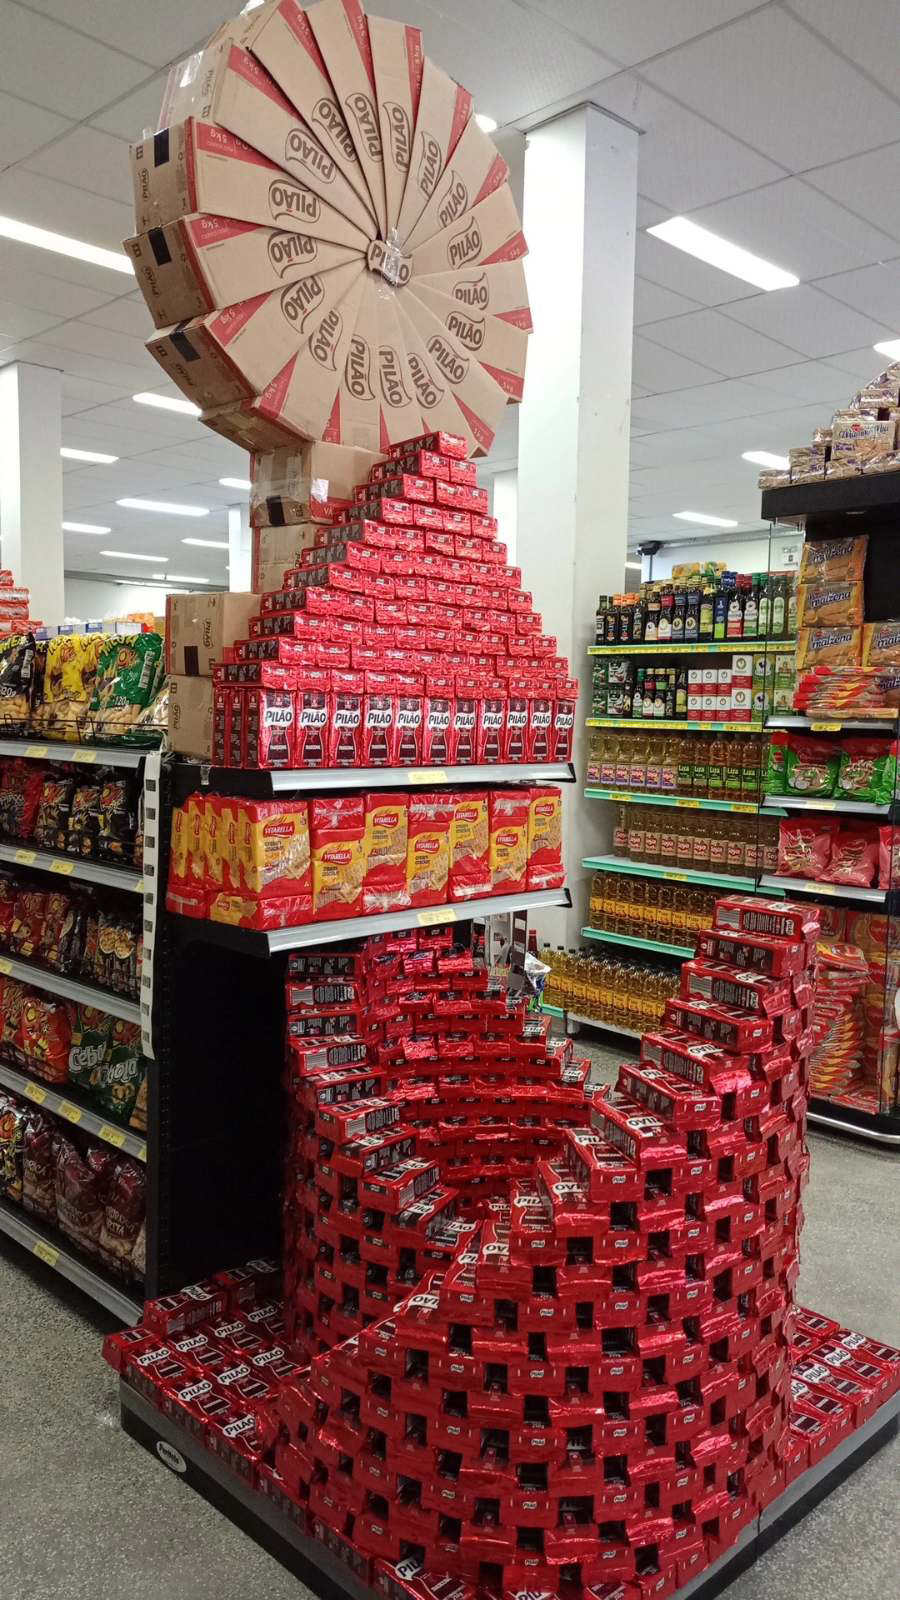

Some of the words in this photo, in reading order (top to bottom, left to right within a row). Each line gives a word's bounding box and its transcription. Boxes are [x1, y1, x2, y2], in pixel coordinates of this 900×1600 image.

[354, 97, 381, 158] PILÃO
[391, 107, 410, 170] PILÃO
[289, 133, 335, 181] PILÃO
[420, 140, 439, 197] PILÃO
[271, 186, 317, 218] PILÃO
[439, 182, 466, 229] PILÃO
[270, 234, 316, 263] PILÃO
[450, 229, 480, 266] PILÃO
[369, 243, 410, 282] PIO
[284, 275, 322, 322] PILÃO
[455, 283, 488, 306] PILÃO
[313, 309, 339, 362] PILÃO
[448, 315, 483, 347] PILÃO
[350, 337, 368, 397] PILÃO
[428, 338, 465, 381] PILÃO
[379, 350, 403, 406] PILÃO
[408, 355, 437, 407] PILÃO
[811, 591, 851, 609] maizena
[812, 634, 852, 650] maizena
[877, 636, 900, 650] maiz
[265, 710, 292, 724] PILÃO
[301, 711, 326, 725] PILÃO
[335, 712, 360, 725] PILÃO
[368, 712, 392, 725] PILÃO
[397, 712, 420, 725] PILÃO
[428, 714, 450, 726] PILÃO
[455, 714, 475, 726] PILÃO
[483, 714, 503, 726] PILÃO
[508, 713, 527, 725] PILÃO
[532, 713, 551, 725] PILÃO
[555, 715, 573, 727] PILÃO
[416, 842, 438, 850] VITARELLA
[249, 1306, 278, 1322] PILÃO
[217, 1321, 245, 1337] PILÃO
[178, 1335, 208, 1351] PILÃO
[139, 1349, 170, 1364] PILÃO
[255, 1348, 284, 1365] PILÃO
[219, 1366, 250, 1383] PILÃO
[180, 1381, 212, 1399] PILÃO
[224, 1417, 255, 1435] PILÃO
